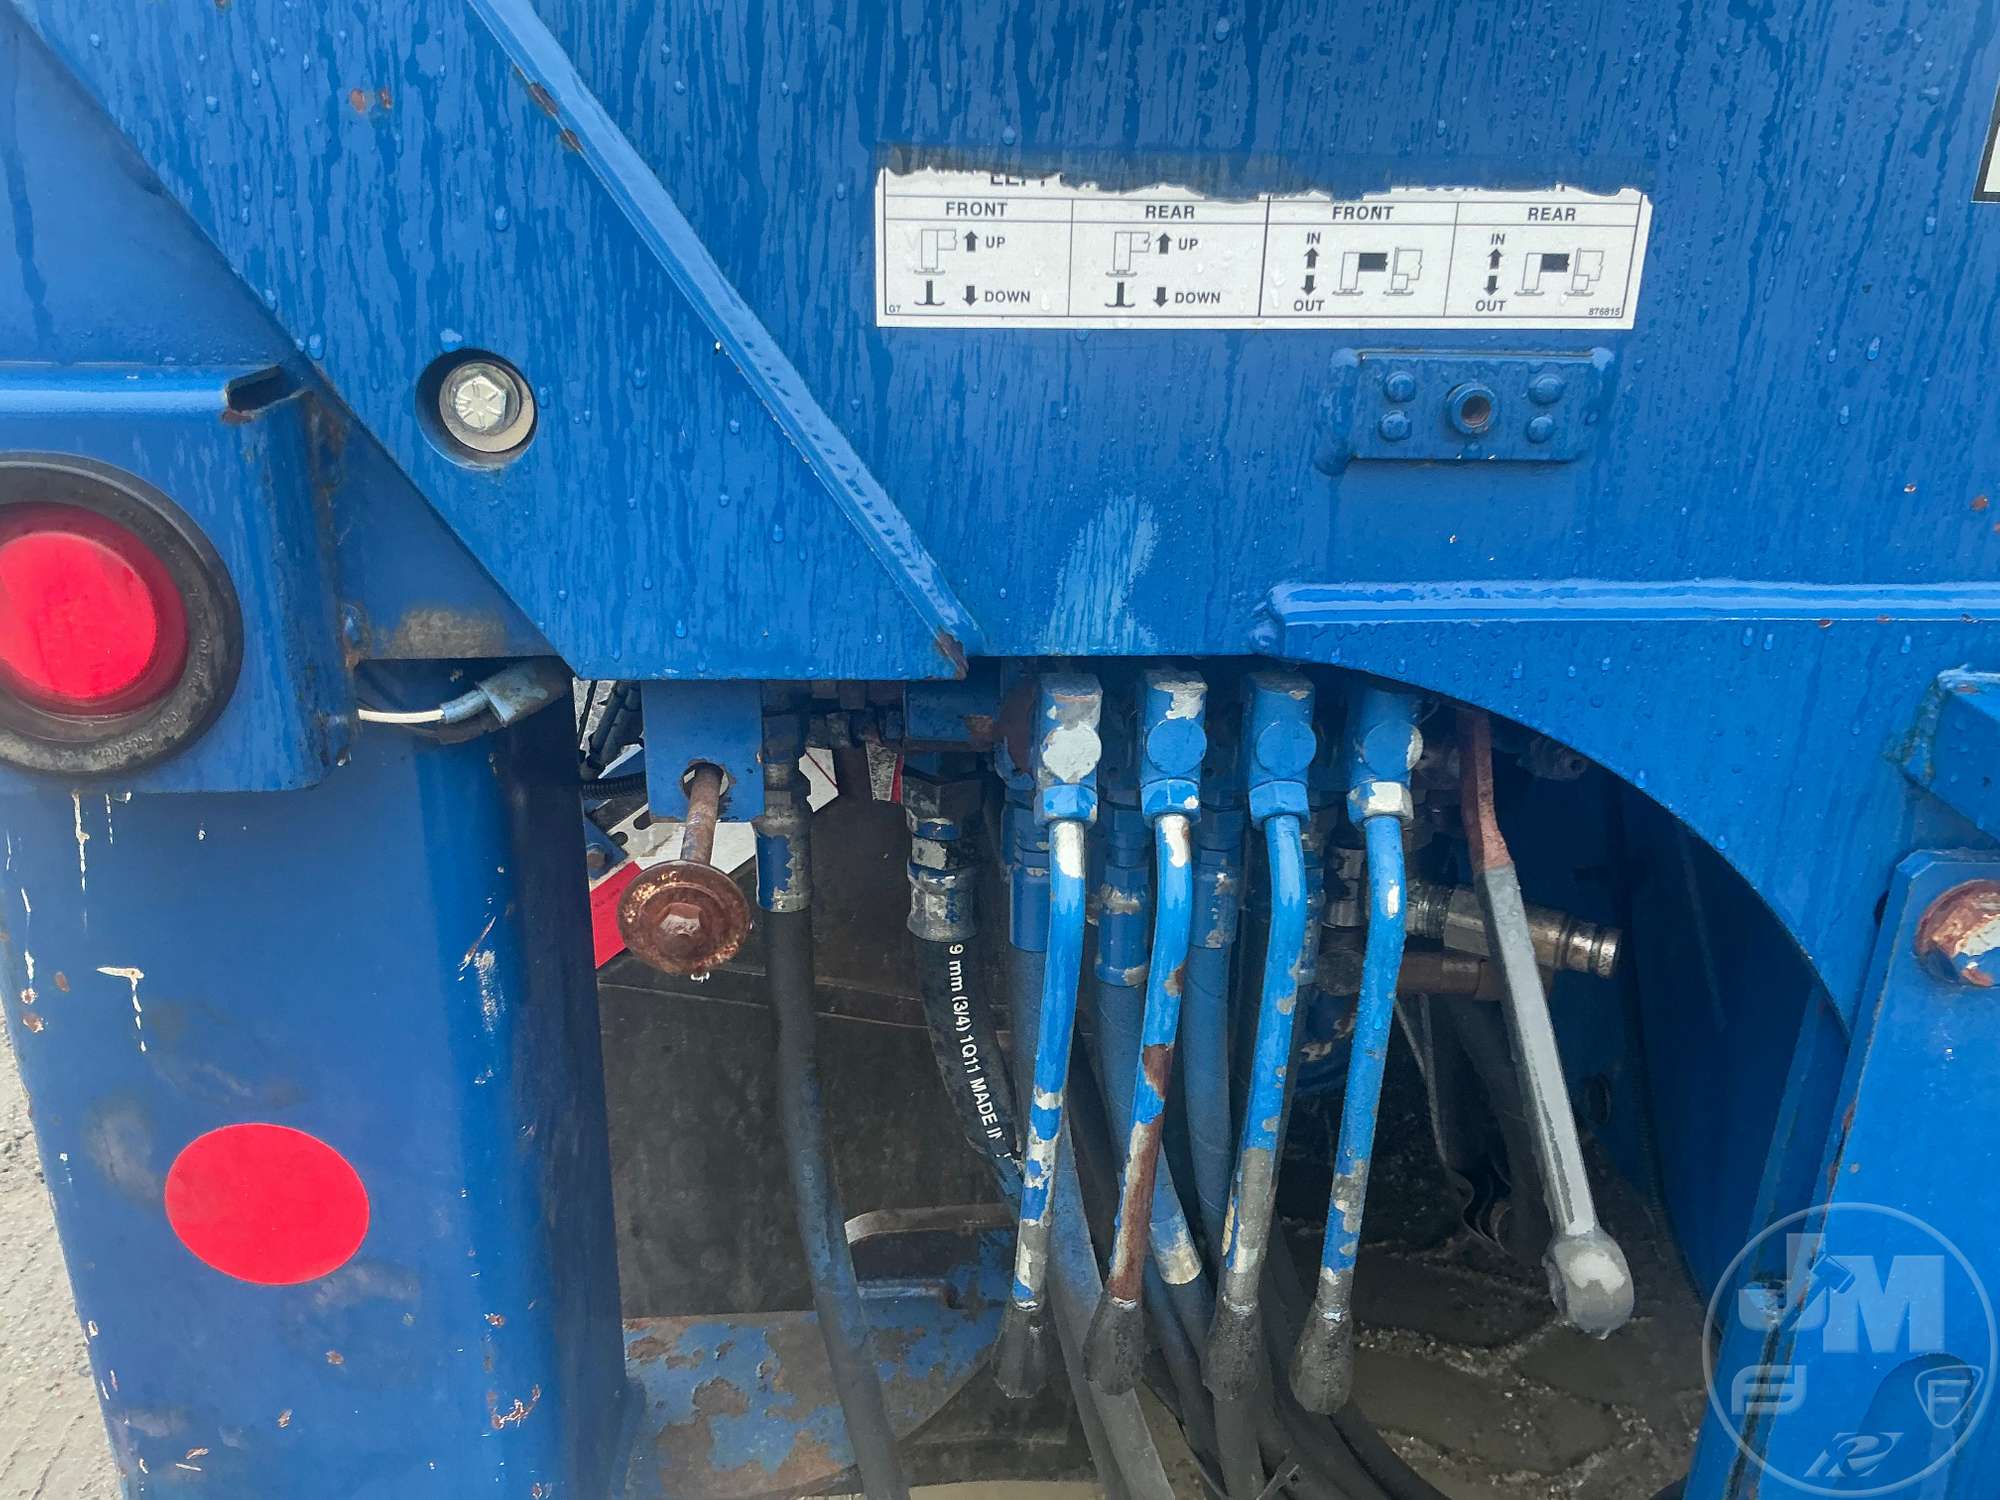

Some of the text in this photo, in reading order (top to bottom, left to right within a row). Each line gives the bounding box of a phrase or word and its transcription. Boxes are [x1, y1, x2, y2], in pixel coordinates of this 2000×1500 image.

[946, 201, 1008, 216] FRONT
[1145, 205, 1195, 219] REAR
[1332, 206, 1394, 220] FRONT
[1528, 207, 1576, 221] REAR
[986, 236, 1005, 248] UP
[1179, 238, 1198, 250] UP
[1306, 232, 1321, 244] IN
[1491, 233, 1505, 245] IN
[985, 290, 1030, 303] DOWN
[1175, 292, 1220, 304] DOWN
[1294, 300, 1325, 312] OUT
[1475, 300, 1506, 312] OUT
[1588, 307, 1620, 316] 876815
[950, 944, 963, 954] 9
[949, 960, 962, 991] mm
[952, 996, 971, 1031] (3/4)
[960, 1035, 981, 1073] 1Q11
[970, 1077, 998, 1126] MADE
